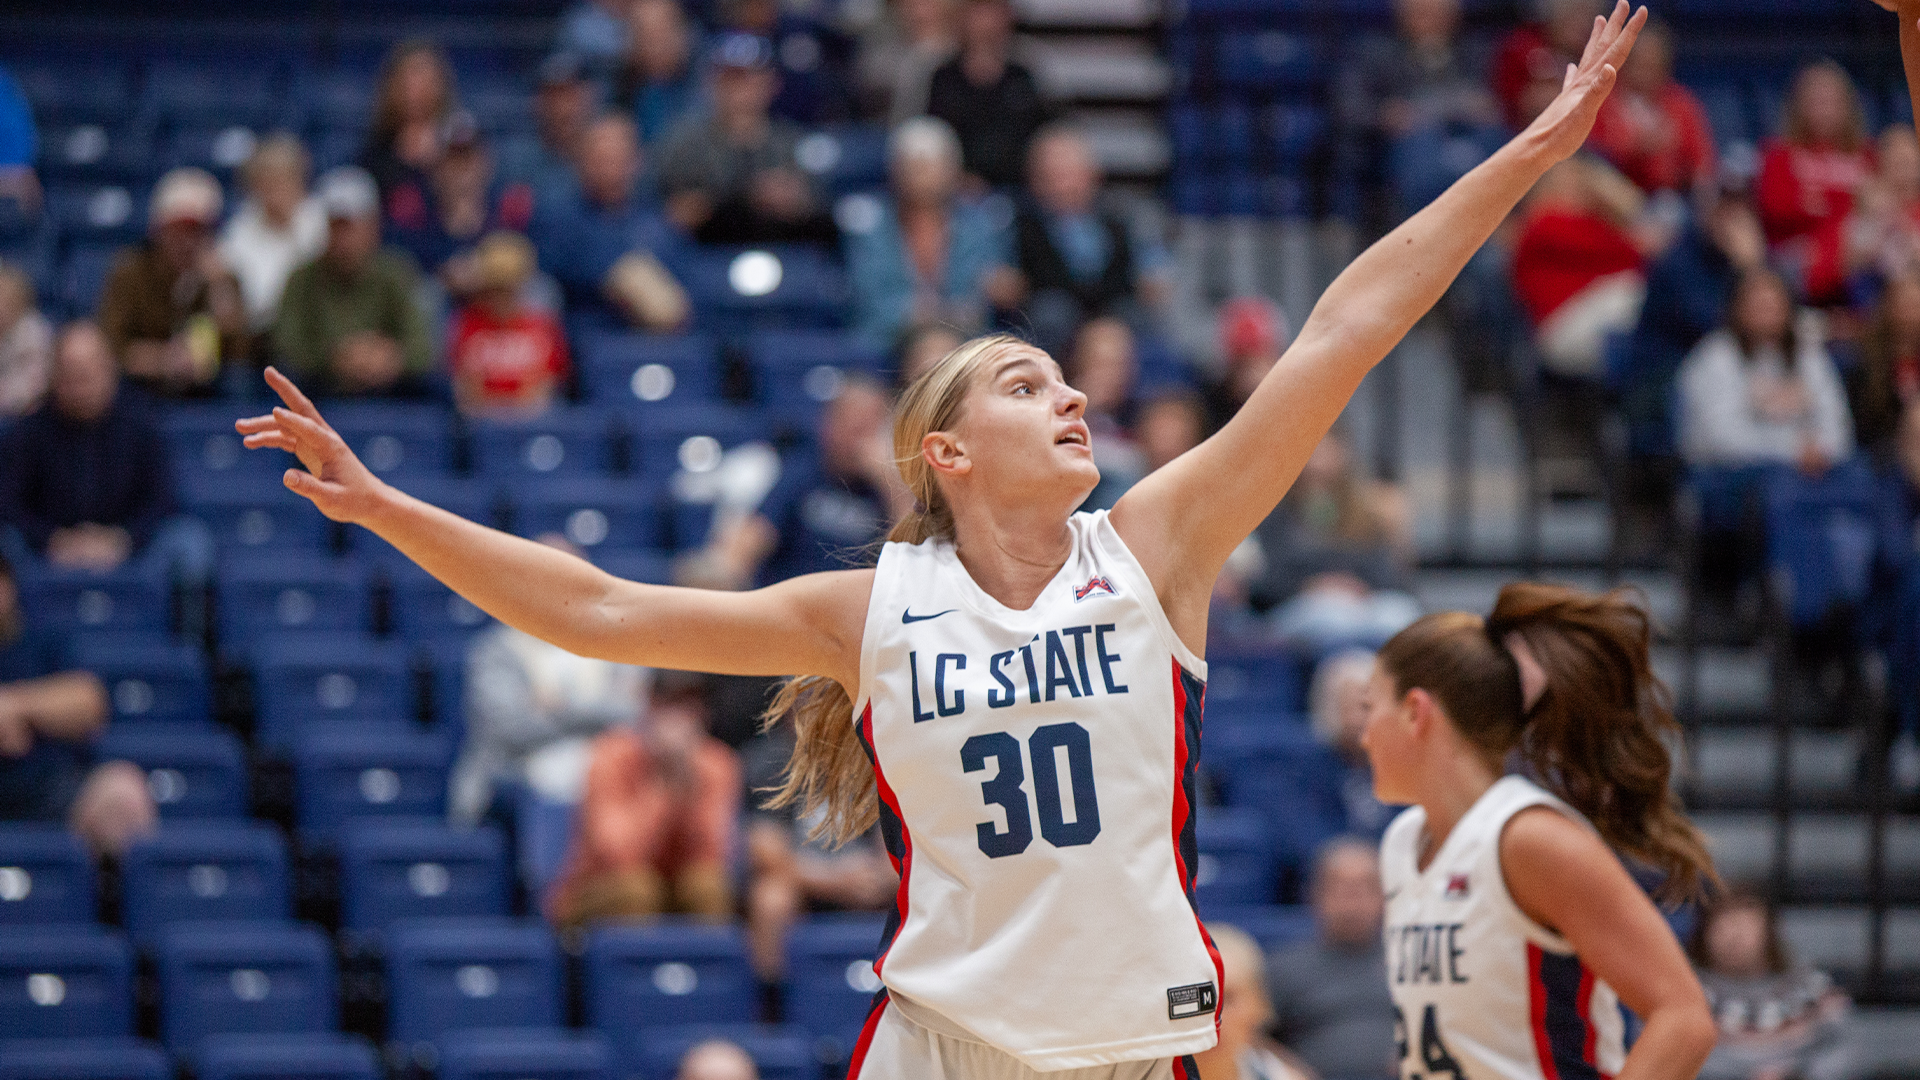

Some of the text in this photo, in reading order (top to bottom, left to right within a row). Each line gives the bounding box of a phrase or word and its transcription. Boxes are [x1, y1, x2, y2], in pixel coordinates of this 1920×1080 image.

[909, 623, 1130, 724] LC STATE
[959, 721, 1102, 860] 30
[1203, 990, 1213, 1006] M
